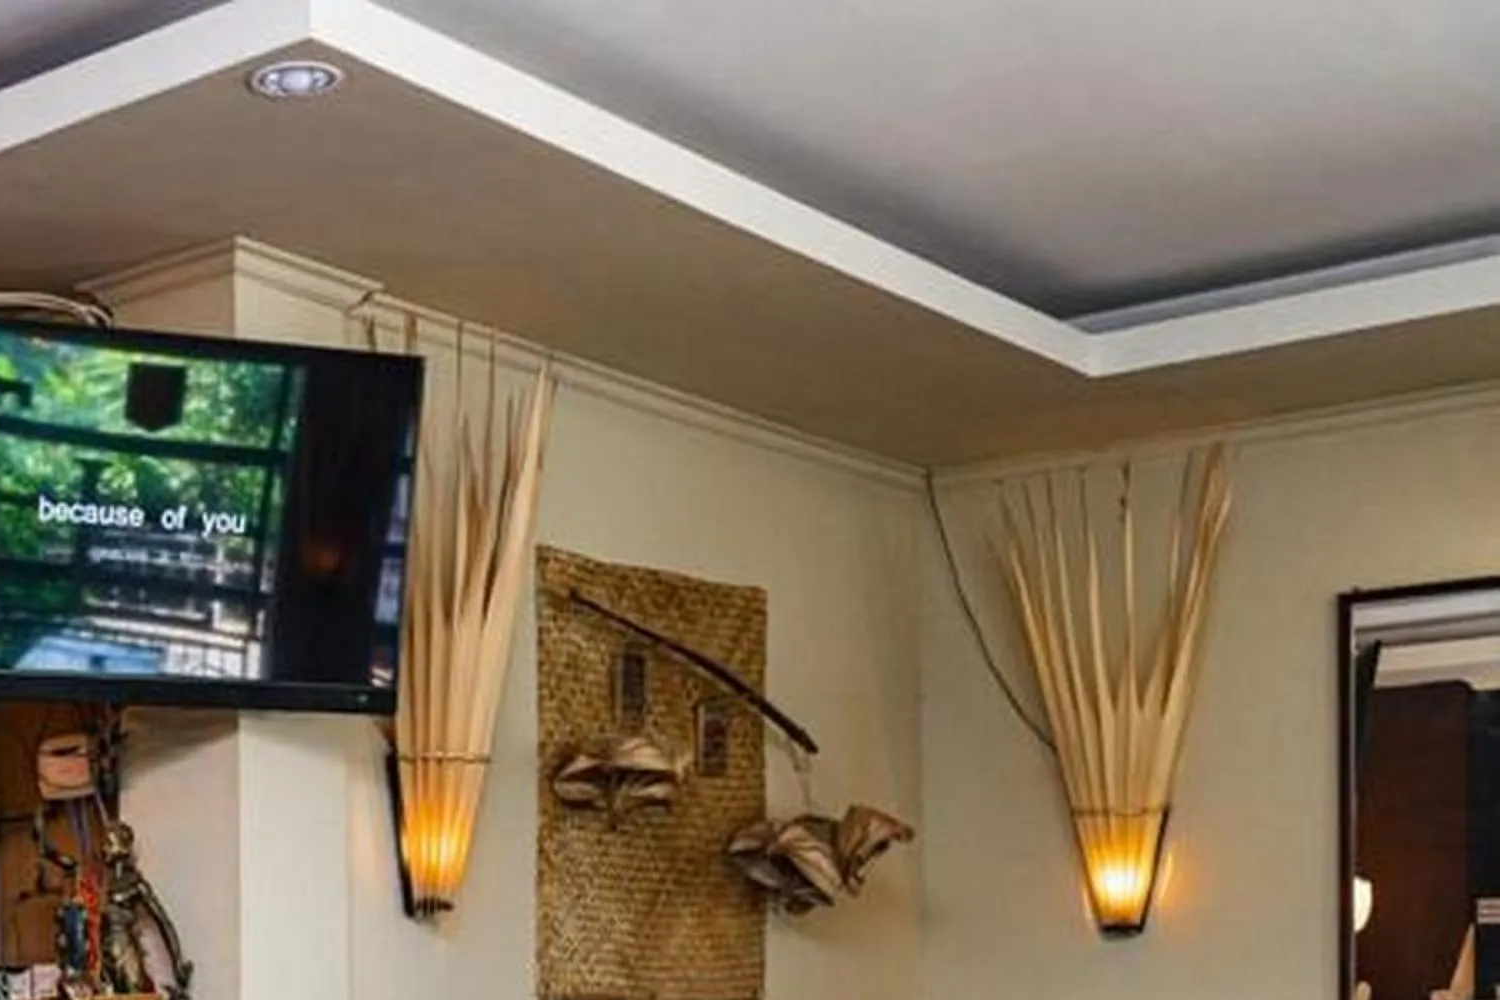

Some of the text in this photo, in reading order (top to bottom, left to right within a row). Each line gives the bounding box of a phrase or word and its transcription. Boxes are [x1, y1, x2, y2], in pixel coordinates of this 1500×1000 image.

[38, 495, 247, 539] because of you
